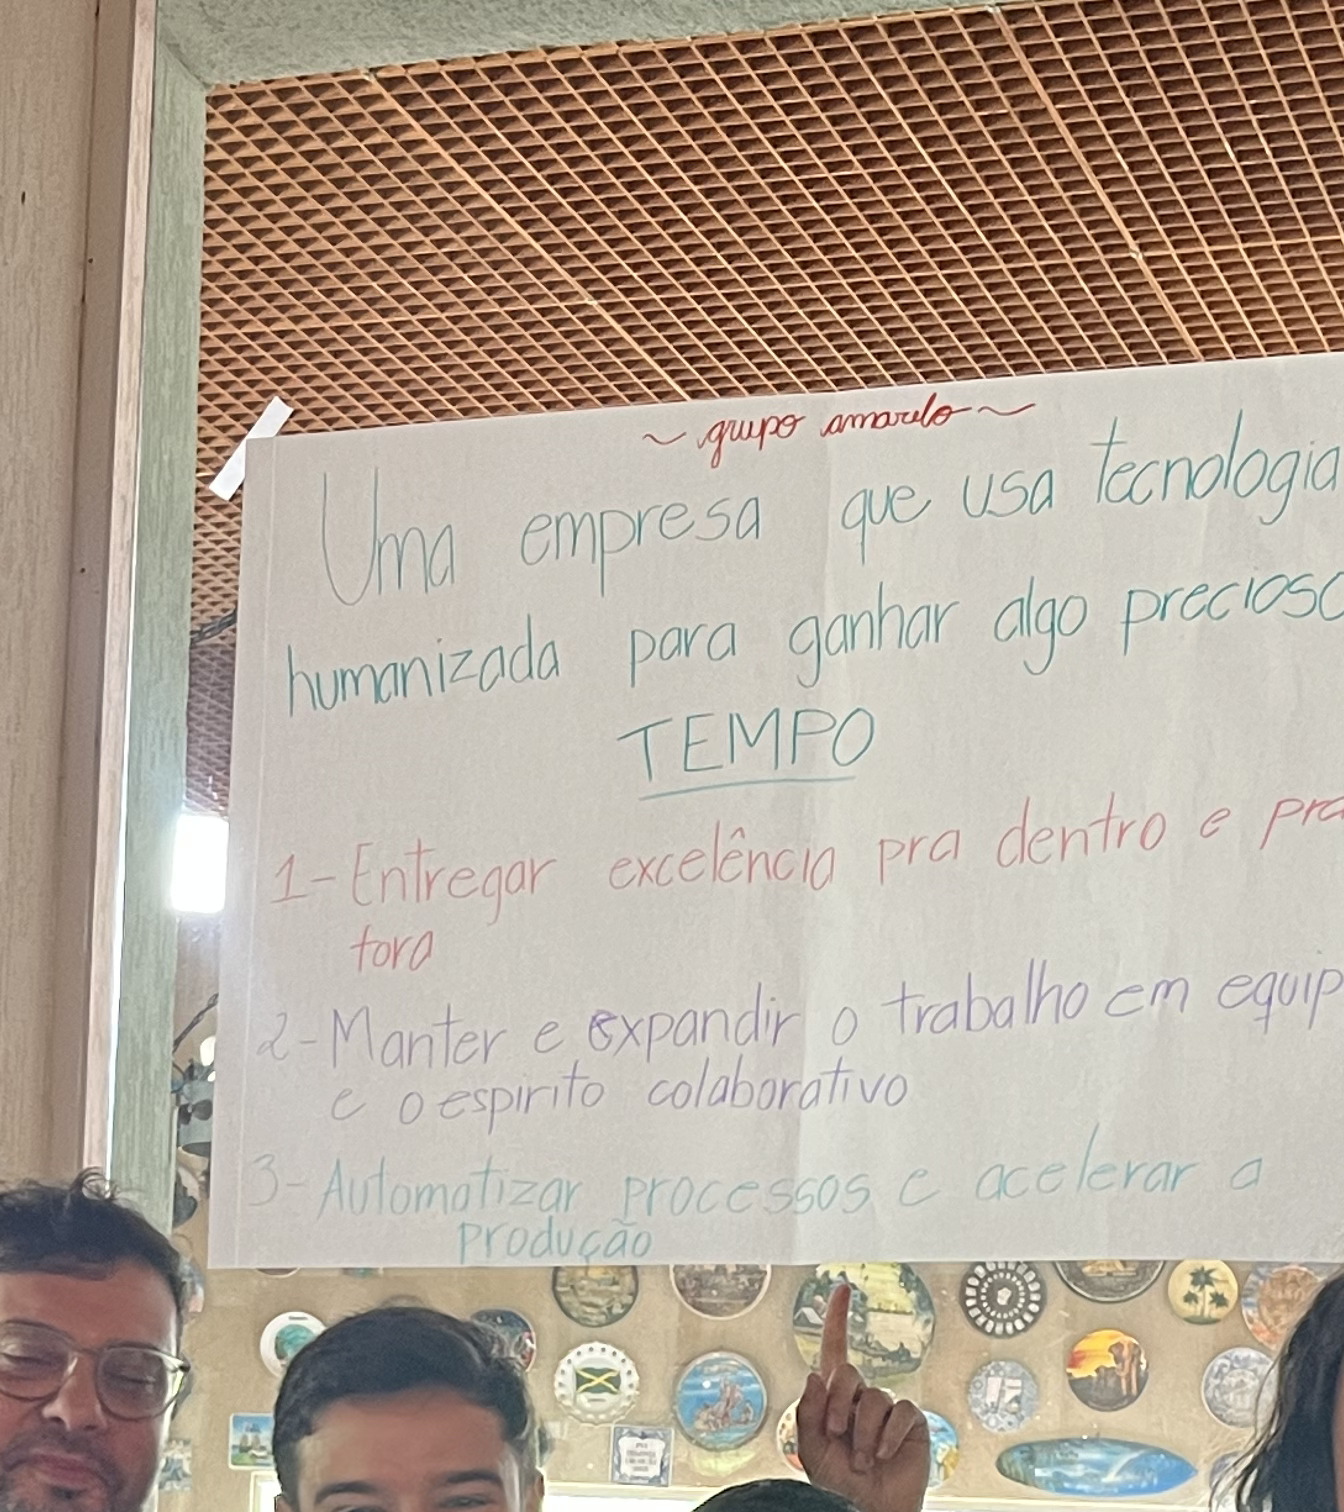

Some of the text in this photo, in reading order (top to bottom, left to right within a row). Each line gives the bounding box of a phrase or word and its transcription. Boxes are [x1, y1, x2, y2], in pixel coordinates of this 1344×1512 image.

[698, 392, 972, 469] grupo amarelo
[322, 409, 1341, 605] Uma empresa que usa tecnologia
[288, 613, 560, 716] humanizada
[630, 621, 736, 687] para
[789, 581, 959, 688] ganhar
[994, 576, 1088, 674] algo
[618, 707, 874, 782] TEMPO
[352, 837, 557, 925] Entregar
[609, 820, 835, 891] excelência
[879, 829, 960, 884] pra
[996, 792, 1166, 868] dentro
[1199, 806, 1230, 839] e
[332, 1003, 507, 1069] Manter
[534, 1019, 565, 1054] e
[831, 1005, 858, 1046] o
[881, 957, 1088, 1035] trabalho
[1104, 975, 1189, 1018] em
[331, 1087, 367, 1121] e
[399, 1091, 424, 1125] o
[648, 1053, 908, 1112] colaborativo
[316, 1154, 583, 1221] Automatizar
[623, 1166, 871, 1219] processos
[899, 1166, 940, 1206] e
[974, 1122, 1197, 1200] acelerar
[1230, 1157, 1262, 1190] a
[459, 1215, 652, 1265] produção
